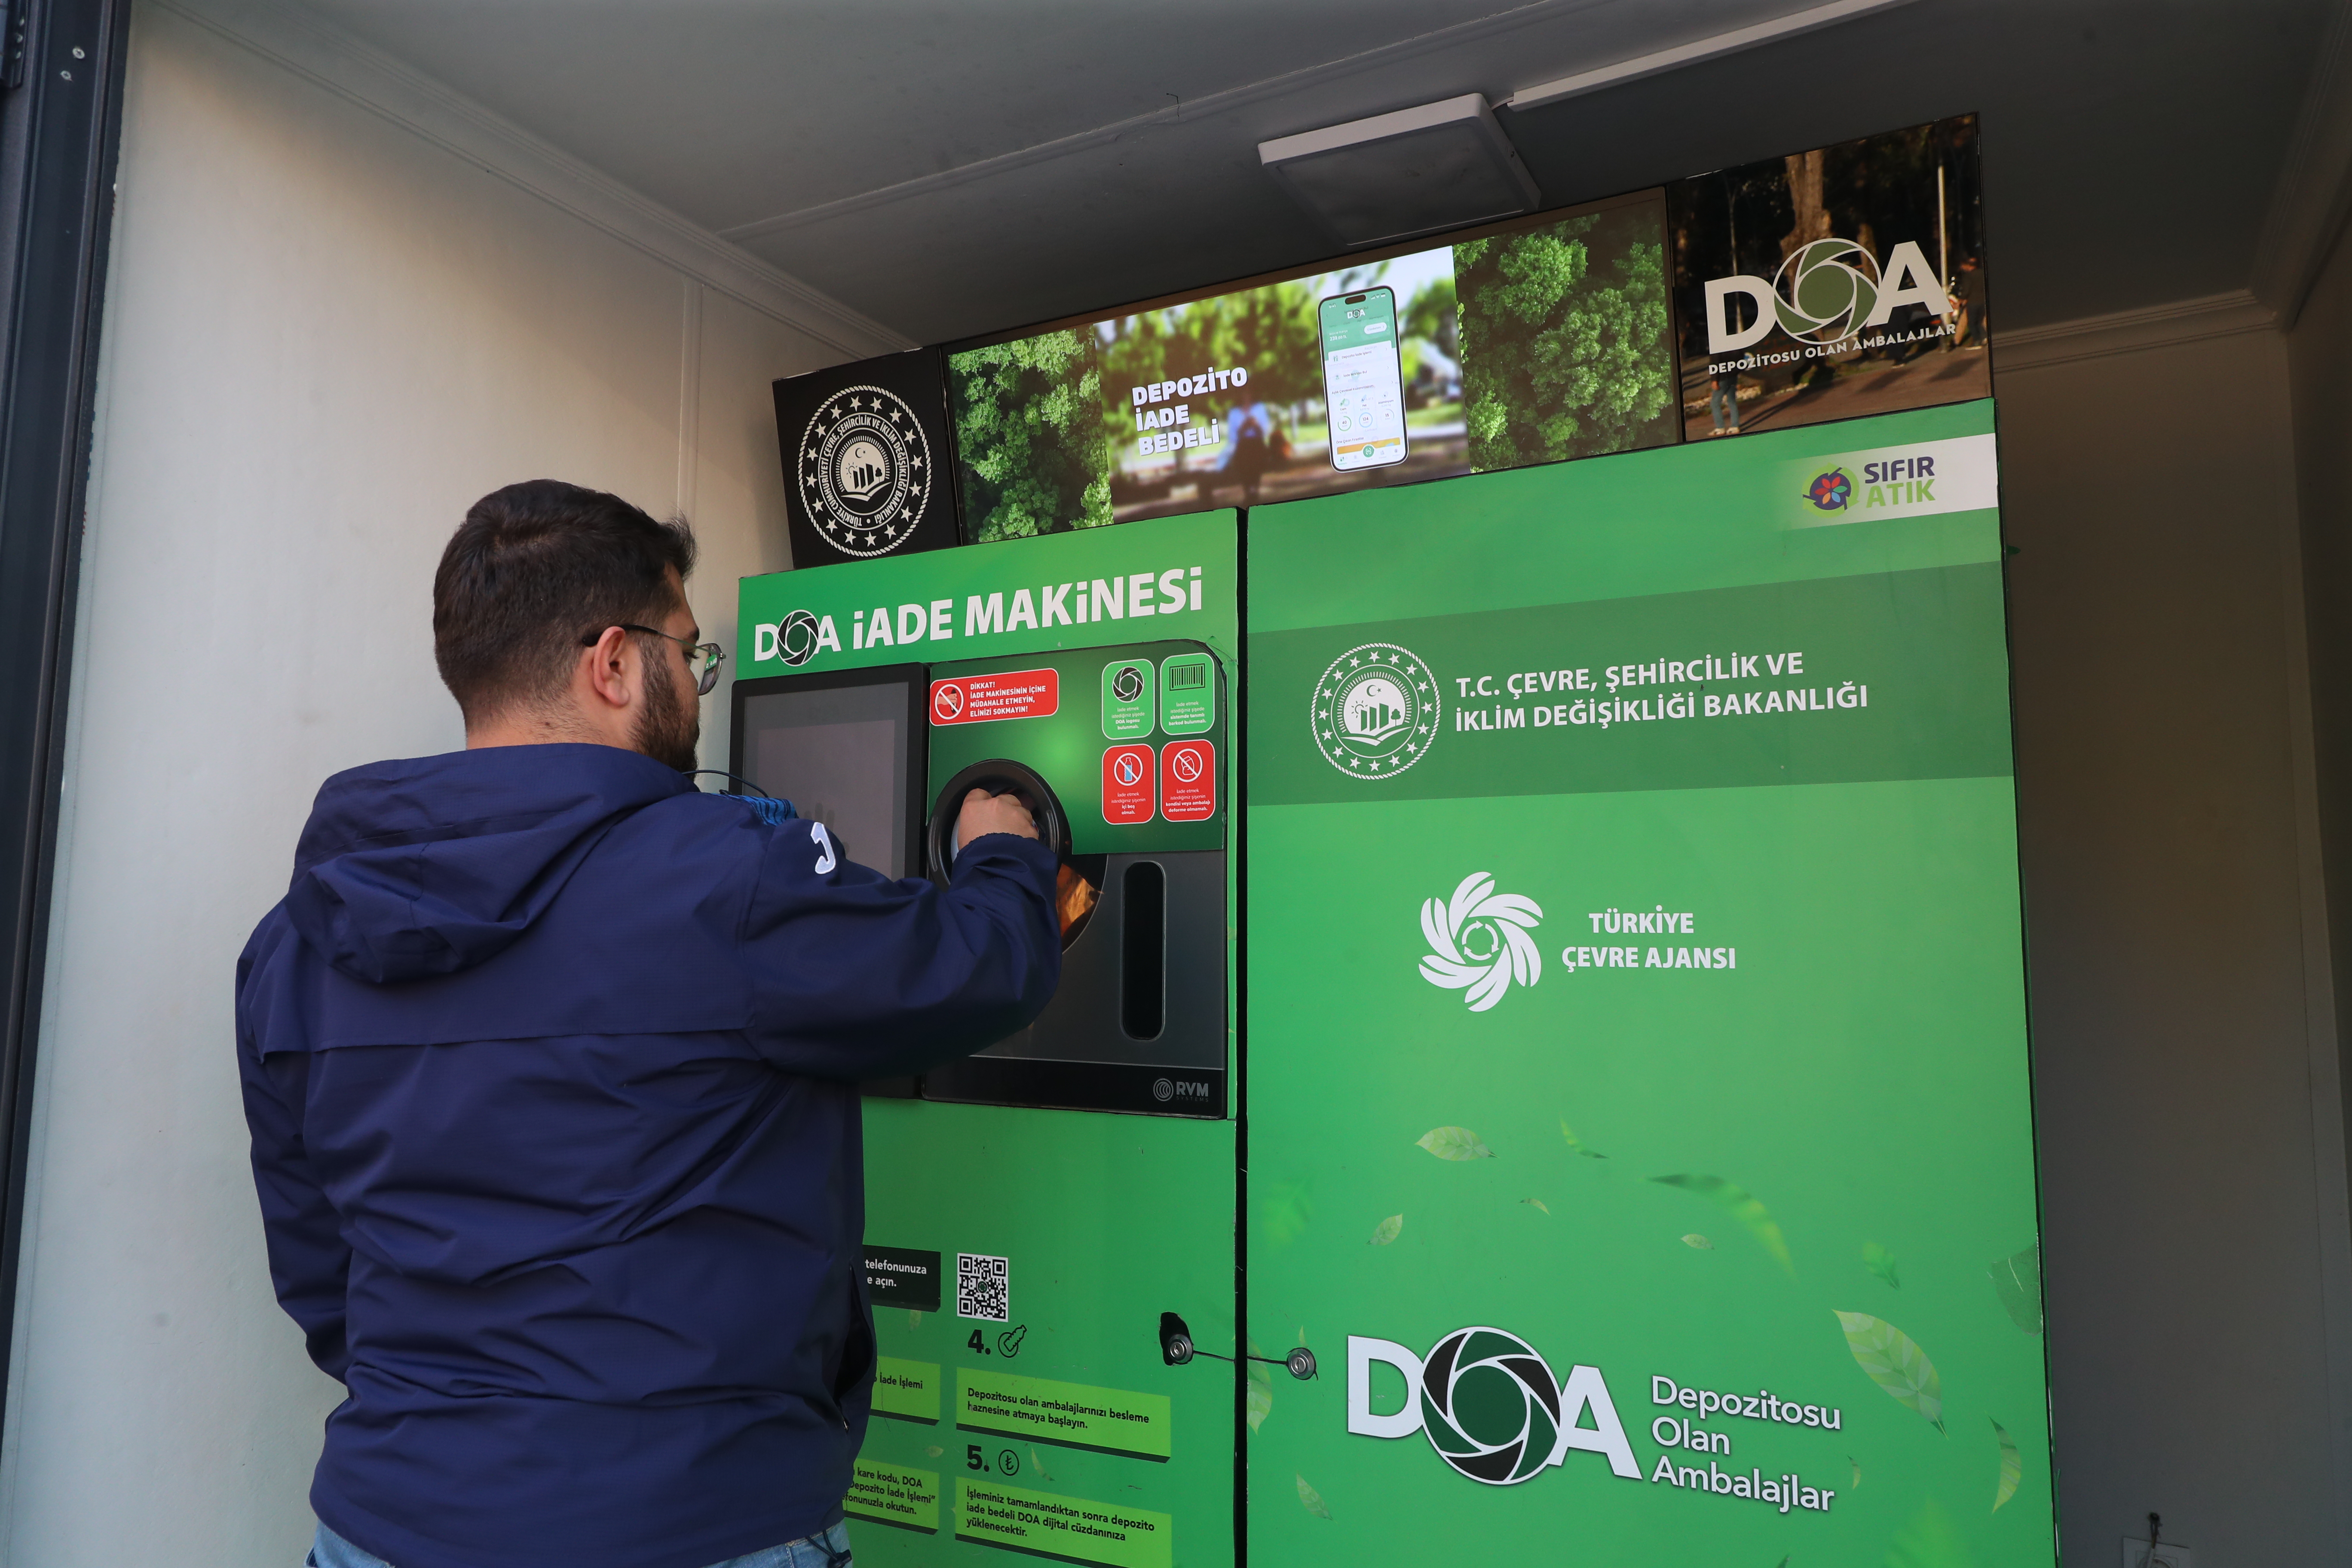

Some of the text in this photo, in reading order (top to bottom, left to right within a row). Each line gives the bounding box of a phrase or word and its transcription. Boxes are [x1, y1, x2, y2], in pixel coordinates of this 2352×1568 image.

[1704, 238, 1954, 354] DOA
[1709, 323, 1956, 375] DEPOZİTOSU OLAN AMBALAJLAR
[1132, 366, 1247, 406] DEPOZİTO
[1135, 404, 1190, 432] İADE
[1138, 418, 1220, 456] BEDELİ
[820, 415, 907, 527] TÜRKİYE CUMHURİYETİ ÇEVRE, ŞEHİRCİLİK VE İKLİM DEĞİŞİKLİĞİ BAKANLIĞI
[1864, 456, 1936, 484] SIFIR
[1866, 479, 1936, 508] ATIK
[754, 609, 842, 667] DOA
[970, 681, 995, 690] DİKKAT!
[1456, 652, 1804, 700] T.C. ÇEVRE, ŞEHİRCİLİK VE
[970, 685, 1046, 699] İADE MAKİNESİNİN İÇİNE
[970, 696, 1035, 708] MÜDAHALE ETMEYİN,
[1456, 680, 1868, 732] İKLİM DEĞİŞİKLİĞİ BAKANLIĞI
[970, 706, 1028, 717] ELİNİZİ SOKMAYIN!
[1588, 904, 1694, 934] TÜRKİYE
[1562, 946, 1736, 973] ÇEVRE AJANSI
[1176, 1081, 1208, 1096] RVM
[865, 1259, 927, 1274] telefonunuza
[875, 1277, 897, 1289] açın.
[968, 1329, 991, 1355] 4.
[880, 1372, 897, 1385] İade
[899, 1375, 923, 1389] İşlemi
[967, 1401, 1088, 1430] haznesine atmaya başlayın.
[968, 1387, 1149, 1424] Depozitosu olan ambalajlarınızı besleme
[1348, 1326, 1642, 1485] DOA
[1652, 1375, 1841, 1430] Depozitosu
[1652, 1417, 1730, 1455] Olan
[967, 1444, 990, 1472] 5.
[858, 1467, 875, 1479] kare
[877, 1470, 900, 1485] kodu,
[902, 1476, 923, 1488] DOA
[887, 1485, 904, 1498] İade
[1652, 1455, 1834, 1513] Ambalajlar
[886, 1501, 917, 1515] okutun.
[967, 1485, 1155, 1531] İşleminiz tamamlandıktan sonra depozito
[967, 1503, 1126, 1542] iade bedeli DOA dijital cüzdanınıza
[966, 1517, 1028, 1537] yüklenecektir.
